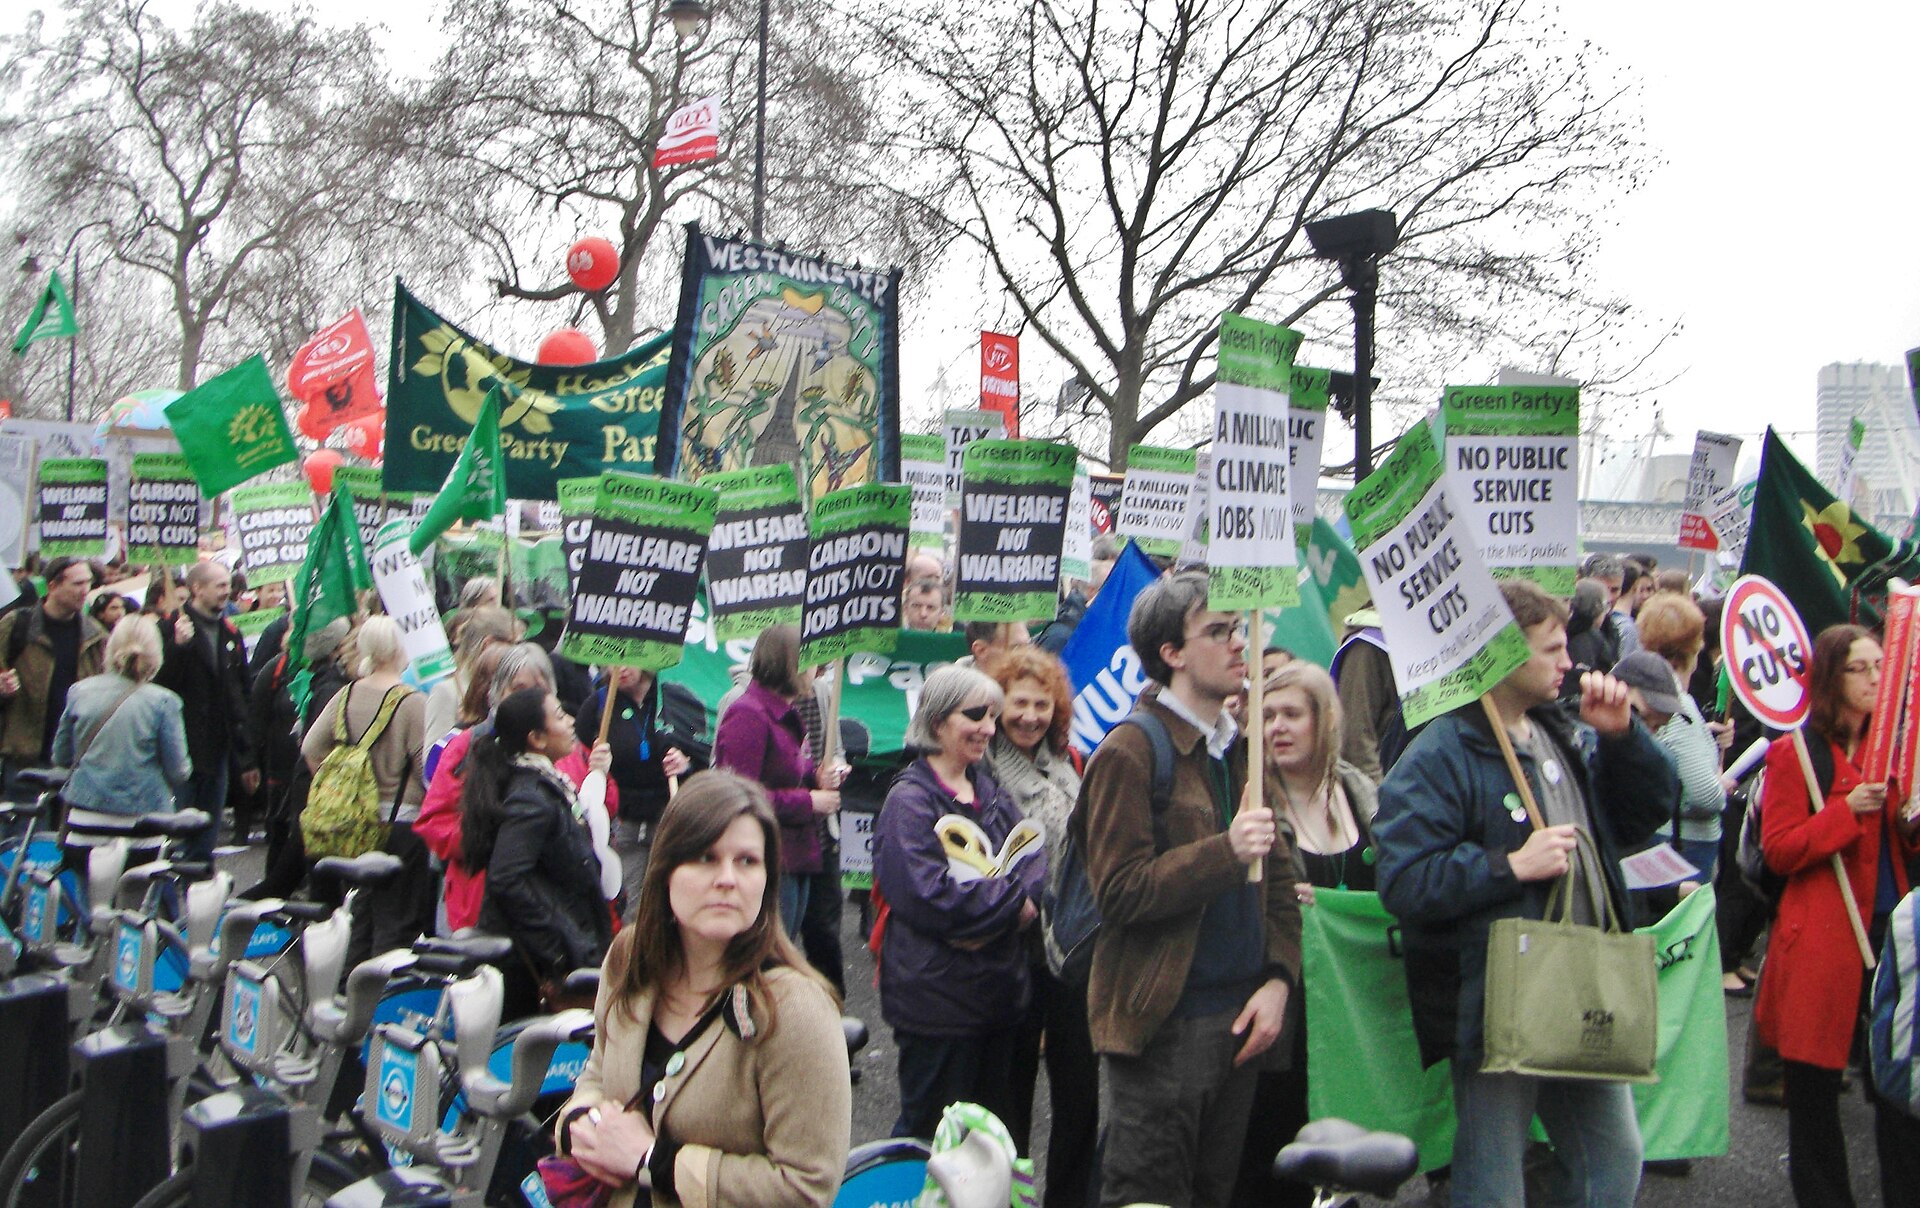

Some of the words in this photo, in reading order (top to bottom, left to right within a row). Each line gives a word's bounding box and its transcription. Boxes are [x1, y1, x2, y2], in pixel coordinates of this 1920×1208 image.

[703, 236, 890, 307] WESTMINSTER
[1220, 319, 1256, 350] Green
[590, 385, 666, 414] Gree
[1450, 390, 1507, 412] Green
[1510, 391, 1562, 415] Party
[409, 425, 466, 455] Gree
[601, 424, 658, 462] Par
[1216, 409, 1229, 444] A
[1231, 410, 1286, 451] MILLION
[1290, 418, 1316, 441] LIC
[967, 444, 1021, 461] Green
[1022, 448, 1064, 467] Party
[1130, 447, 1161, 459] Green
[1163, 449, 1192, 463] Party
[1457, 446, 1490, 471] NO
[1495, 446, 1569, 471] PUBLIC
[562, 482, 597, 498] Gree
[1126, 479, 1136, 491] A
[1138, 480, 1190, 497] MILLION
[1216, 457, 1287, 496] CLIMATE
[1472, 478, 1553, 504] SERVICE
[129, 483, 197, 502] CARBON
[603, 477, 655, 502] Green
[659, 486, 706, 513] Party
[815, 494, 851, 515] Green
[855, 490, 899, 508] Party
[1124, 496, 1187, 513] CLIMATE
[1346, 475, 1391, 521] Green
[129, 504, 167, 523] CUTS
[169, 505, 198, 524] NOT
[239, 507, 313, 532] CARBON
[965, 492, 1065, 525] WELFARE
[1122, 513, 1149, 527] JOBS
[1150, 513, 1185, 531] NOW
[1215, 504, 1255, 541] JOBS
[1259, 505, 1288, 542] NOW
[1488, 510, 1535, 535] CUTS
[129, 525, 160, 544] JOB
[161, 525, 198, 545] CUTS
[242, 529, 283, 550] CUTS
[708, 512, 810, 552] WELFARE
[995, 526, 1033, 552] NOT
[1371, 542, 1406, 585] NO
[1403, 490, 1456, 561] PUBLIC
[246, 546, 279, 568] JOB
[279, 542, 307, 561] CUT
[590, 529, 703, 572] WELFARE
[743, 546, 784, 573] NOT
[809, 531, 905, 572] CARBON
[1486, 543, 1504, 559] the
[1505, 543, 1528, 559] NHS
[1529, 541, 1569, 562] public
[614, 568, 661, 597] NOT
[959, 553, 1058, 583] WARFARE
[1398, 535, 1462, 611] SERVICE
[710, 568, 807, 606] WARFAR
[806, 567, 851, 605] CUTS
[850, 564, 903, 591] NOT
[574, 592, 688, 635] WARFARE
[802, 603, 840, 639] JOB
[841, 595, 897, 625] CUTS
[1427, 581, 1469, 635] CUTS
[1738, 604, 1781, 645] NO
[1406, 655, 1440, 683] Keep
[1742, 642, 1807, 691] CUTS
